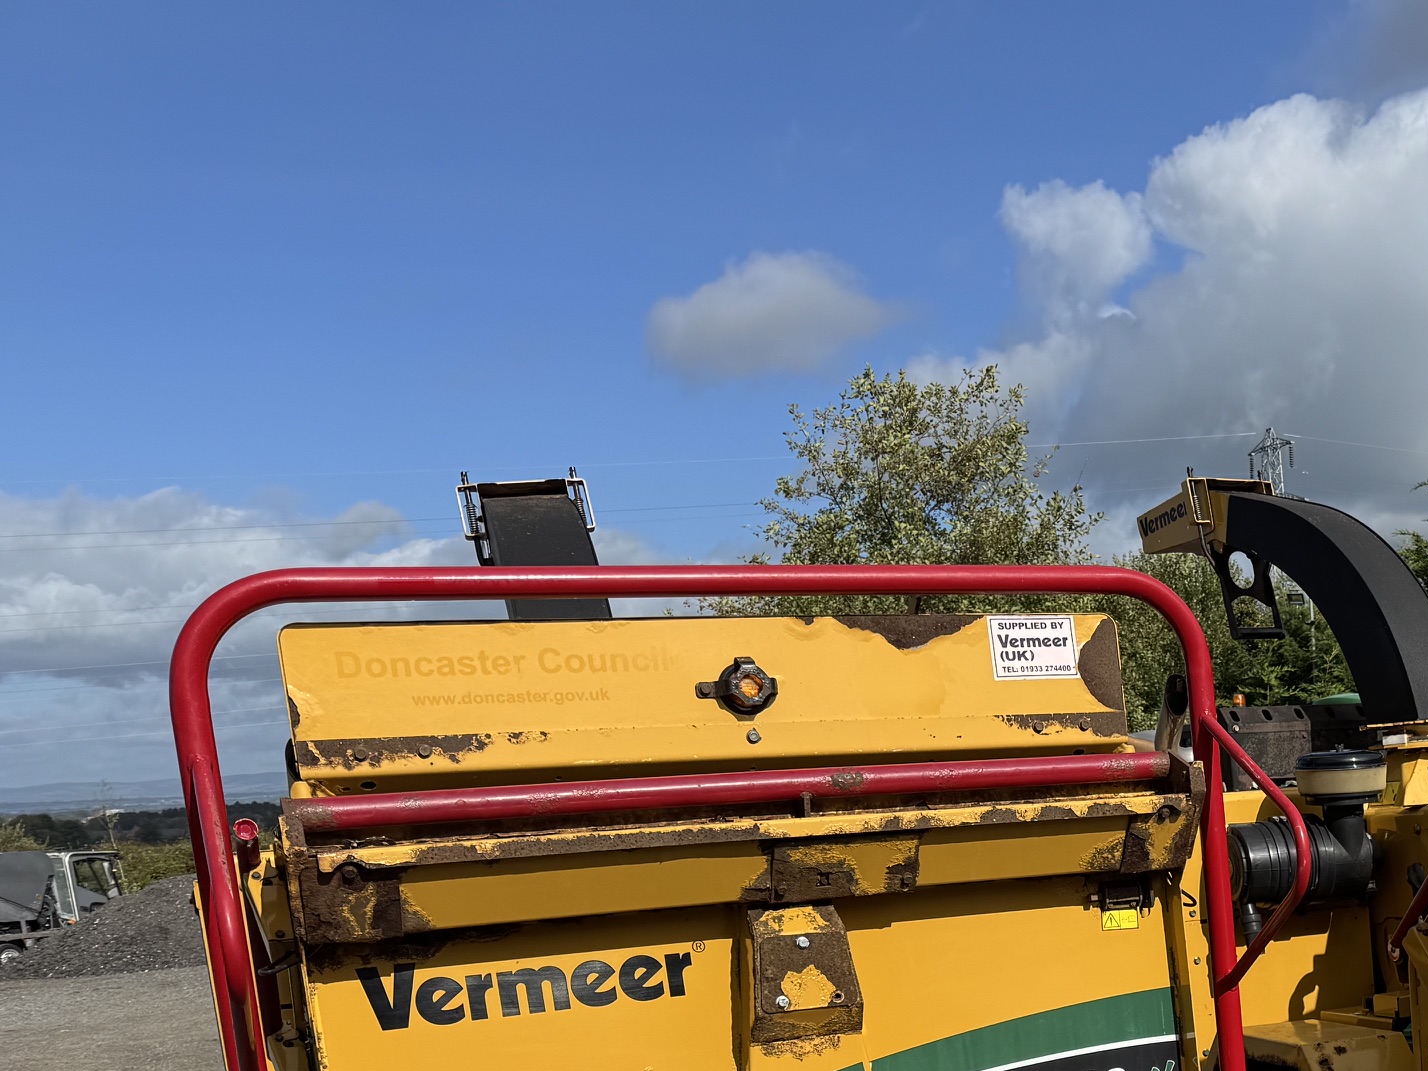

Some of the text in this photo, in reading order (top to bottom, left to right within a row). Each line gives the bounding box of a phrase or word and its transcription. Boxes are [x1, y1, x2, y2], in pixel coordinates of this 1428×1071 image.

[997, 621, 1064, 630] SUPPLIED BY
[997, 634, 1068, 648] Vermeer
[335, 645, 670, 678] Doncaster Council
[1000, 650, 1035, 662] (UK)
[411, 688, 610, 706] www.doncaster.gov.uk
